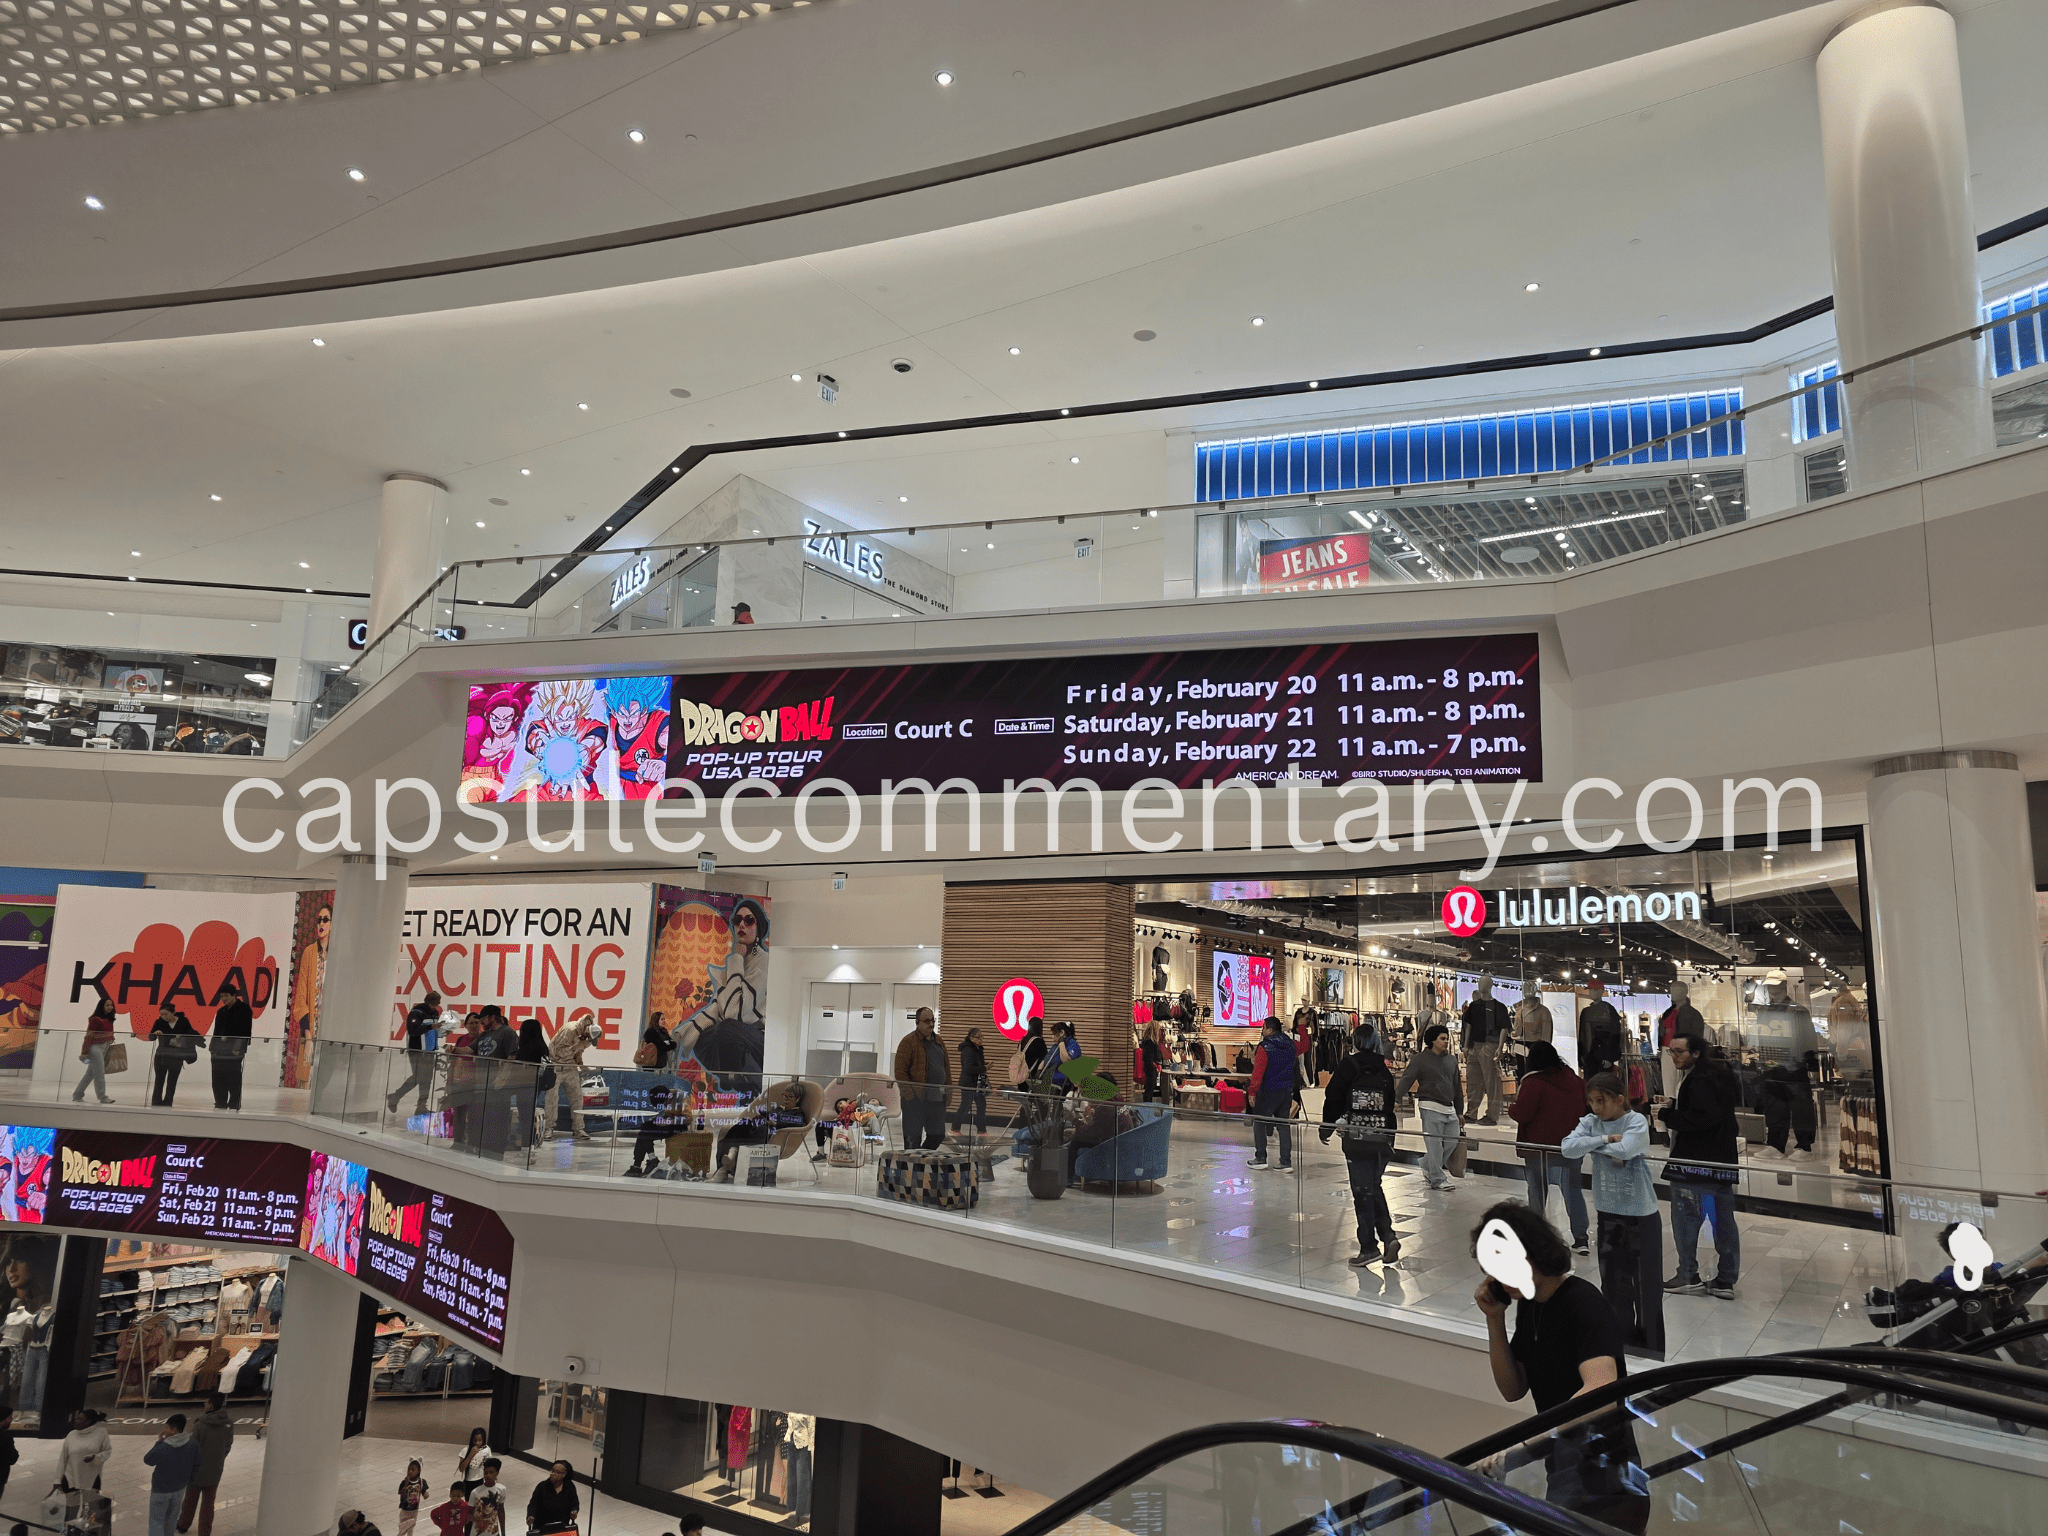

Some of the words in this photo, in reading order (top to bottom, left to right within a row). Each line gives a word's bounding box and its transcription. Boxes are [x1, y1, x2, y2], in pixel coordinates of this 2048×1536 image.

[821, 386, 835, 403] EXIT
[805, 519, 884, 581] ZALES
[1077, 546, 1090, 558] EXIT
[1281, 540, 1348, 578] JEANS
[610, 556, 650, 607] ZALES
[884, 577, 896, 588] THE
[899, 584, 928, 602] DIAMOND
[930, 599, 949, 612] STORE
[1066, 683, 1172, 707] Friday,
[1176, 677, 1279, 703] February
[1287, 675, 1317, 695] 20
[1338, 674, 1363, 692] 11
[1442, 668, 1459, 689] 8
[1468, 669, 1523, 692] p.m.
[679, 697, 780, 746] DRAGON
[779, 695, 836, 743] BALL
[846, 725, 884, 737] Location
[894, 721, 952, 739] Court
[959, 719, 973, 737] C
[1028, 721, 1051, 730] Time
[1064, 711, 1171, 735] Saturday,
[1176, 707, 1278, 732] February
[1287, 706, 1314, 726] 21
[1338, 705, 1363, 724] 11
[1444, 701, 1460, 721] 8
[1470, 701, 1525, 725] p.m.
[686, 750, 764, 766] POP-UP
[767, 750, 822, 764] TOUR
[1063, 743, 1169, 767] Sunday,
[1175, 740, 1278, 763] February
[1286, 738, 1316, 758] 22
[1338, 736, 1363, 757] 11
[1446, 734, 1463, 754] 7
[1470, 734, 1526, 758] p.m.
[701, 765, 744, 779] USA
[747, 765, 804, 779] 2026
[1235, 771, 1293, 782] AMERICAN
[1454, 768, 1472, 776] TOEI
[1474, 767, 1520, 776] ANIMATION
[402, 910, 427, 937] ET
[433, 909, 519, 937] READY
[524, 908, 582, 937] FOR
[586, 907, 631, 937] AN
[1499, 887, 1701, 928] lululemon
[70, 960, 280, 1009] KHAADI
[396, 942, 626, 1000] XCITING
[62, 1146, 122, 1187] DRAGON
[121, 1155, 156, 1188] BALL
[165, 1154, 195, 1168] Court
[196, 1156, 204, 1168] C
[61, 1188, 109, 1201] POP-UP
[110, 1192, 146, 1205] TOUR
[69, 1200, 95, 1211] USA
[98, 1202, 133, 1214] 2026
[159, 1196, 181, 1210] Sat,
[183, 1199, 203, 1211] Feb
[203, 1200, 216, 1212] 21
[224, 1202, 235, 1213] 11
[265, 1205, 272, 1217] 8
[274, 1207, 296, 1220] p.m.
[161, 1182, 182, 1196] Fri,
[186, 1184, 204, 1197] Feb
[205, 1186, 219, 1198] 20
[226, 1188, 237, 1199] 11
[267, 1191, 274, 1202] 8
[276, 1193, 299, 1205] p.m.
[157, 1210, 179, 1225] Sun,
[181, 1213, 200, 1226] Feb
[202, 1215, 215, 1227] 22
[222, 1216, 232, 1228] 11
[264, 1220, 271, 1231] 7
[272, 1222, 295, 1235] p.m.
[431, 1207, 447, 1225] Court
[448, 1213, 453, 1229] C
[367, 1238, 395, 1260] POP-UP
[395, 1248, 416, 1270] TOUR
[427, 1243, 438, 1261] Fri,
[440, 1248, 451, 1265] Feb
[451, 1254, 460, 1269] 20
[462, 1257, 470, 1273] 11
[370, 1255, 386, 1273] USA
[386, 1264, 408, 1283] 2026
[424, 1260, 437, 1281] Sat,
[437, 1266, 450, 1285] Feb
[449, 1272, 457, 1288] 21
[460, 1276, 468, 1293] 11
[422, 1278, 435, 1299] Sun,
[435, 1284, 448, 1302] Feb
[447, 1291, 455, 1307] 22
[458, 1295, 466, 1311] 11
